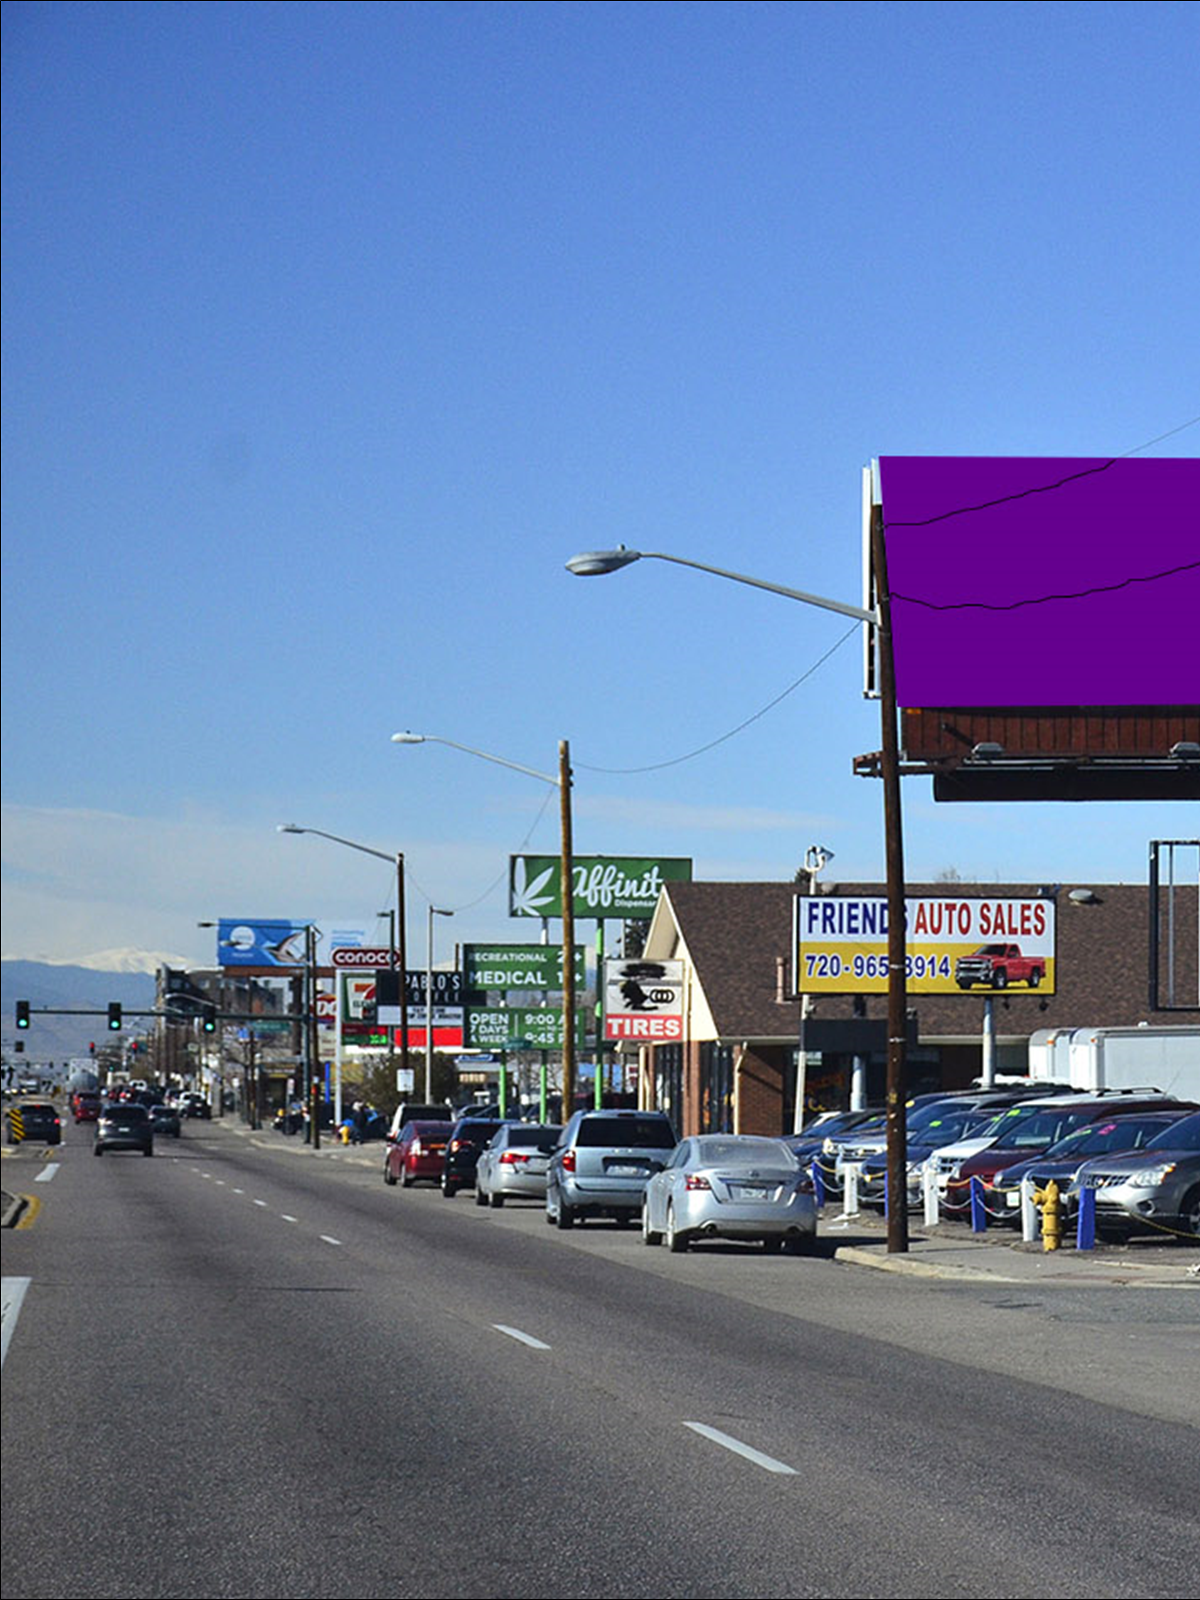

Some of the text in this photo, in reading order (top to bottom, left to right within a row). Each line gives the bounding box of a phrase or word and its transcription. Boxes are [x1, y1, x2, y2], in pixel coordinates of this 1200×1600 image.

[914, 902, 972, 935] AUTO
[979, 902, 1046, 936] SALES
[556, 951, 582, 963] 2+
[805, 953, 951, 978] 720-9658914
[469, 971, 582, 985] MEDICAL 1+
[469, 1013, 509, 1025] OPEN
[524, 1014, 579, 1025] 9:00 A
[478, 1025, 509, 1034] DAYS
[606, 1019, 681, 1036] TIRES
[478, 1034, 509, 1043] WEEK
[524, 1032, 579, 1043] 9:45 P
